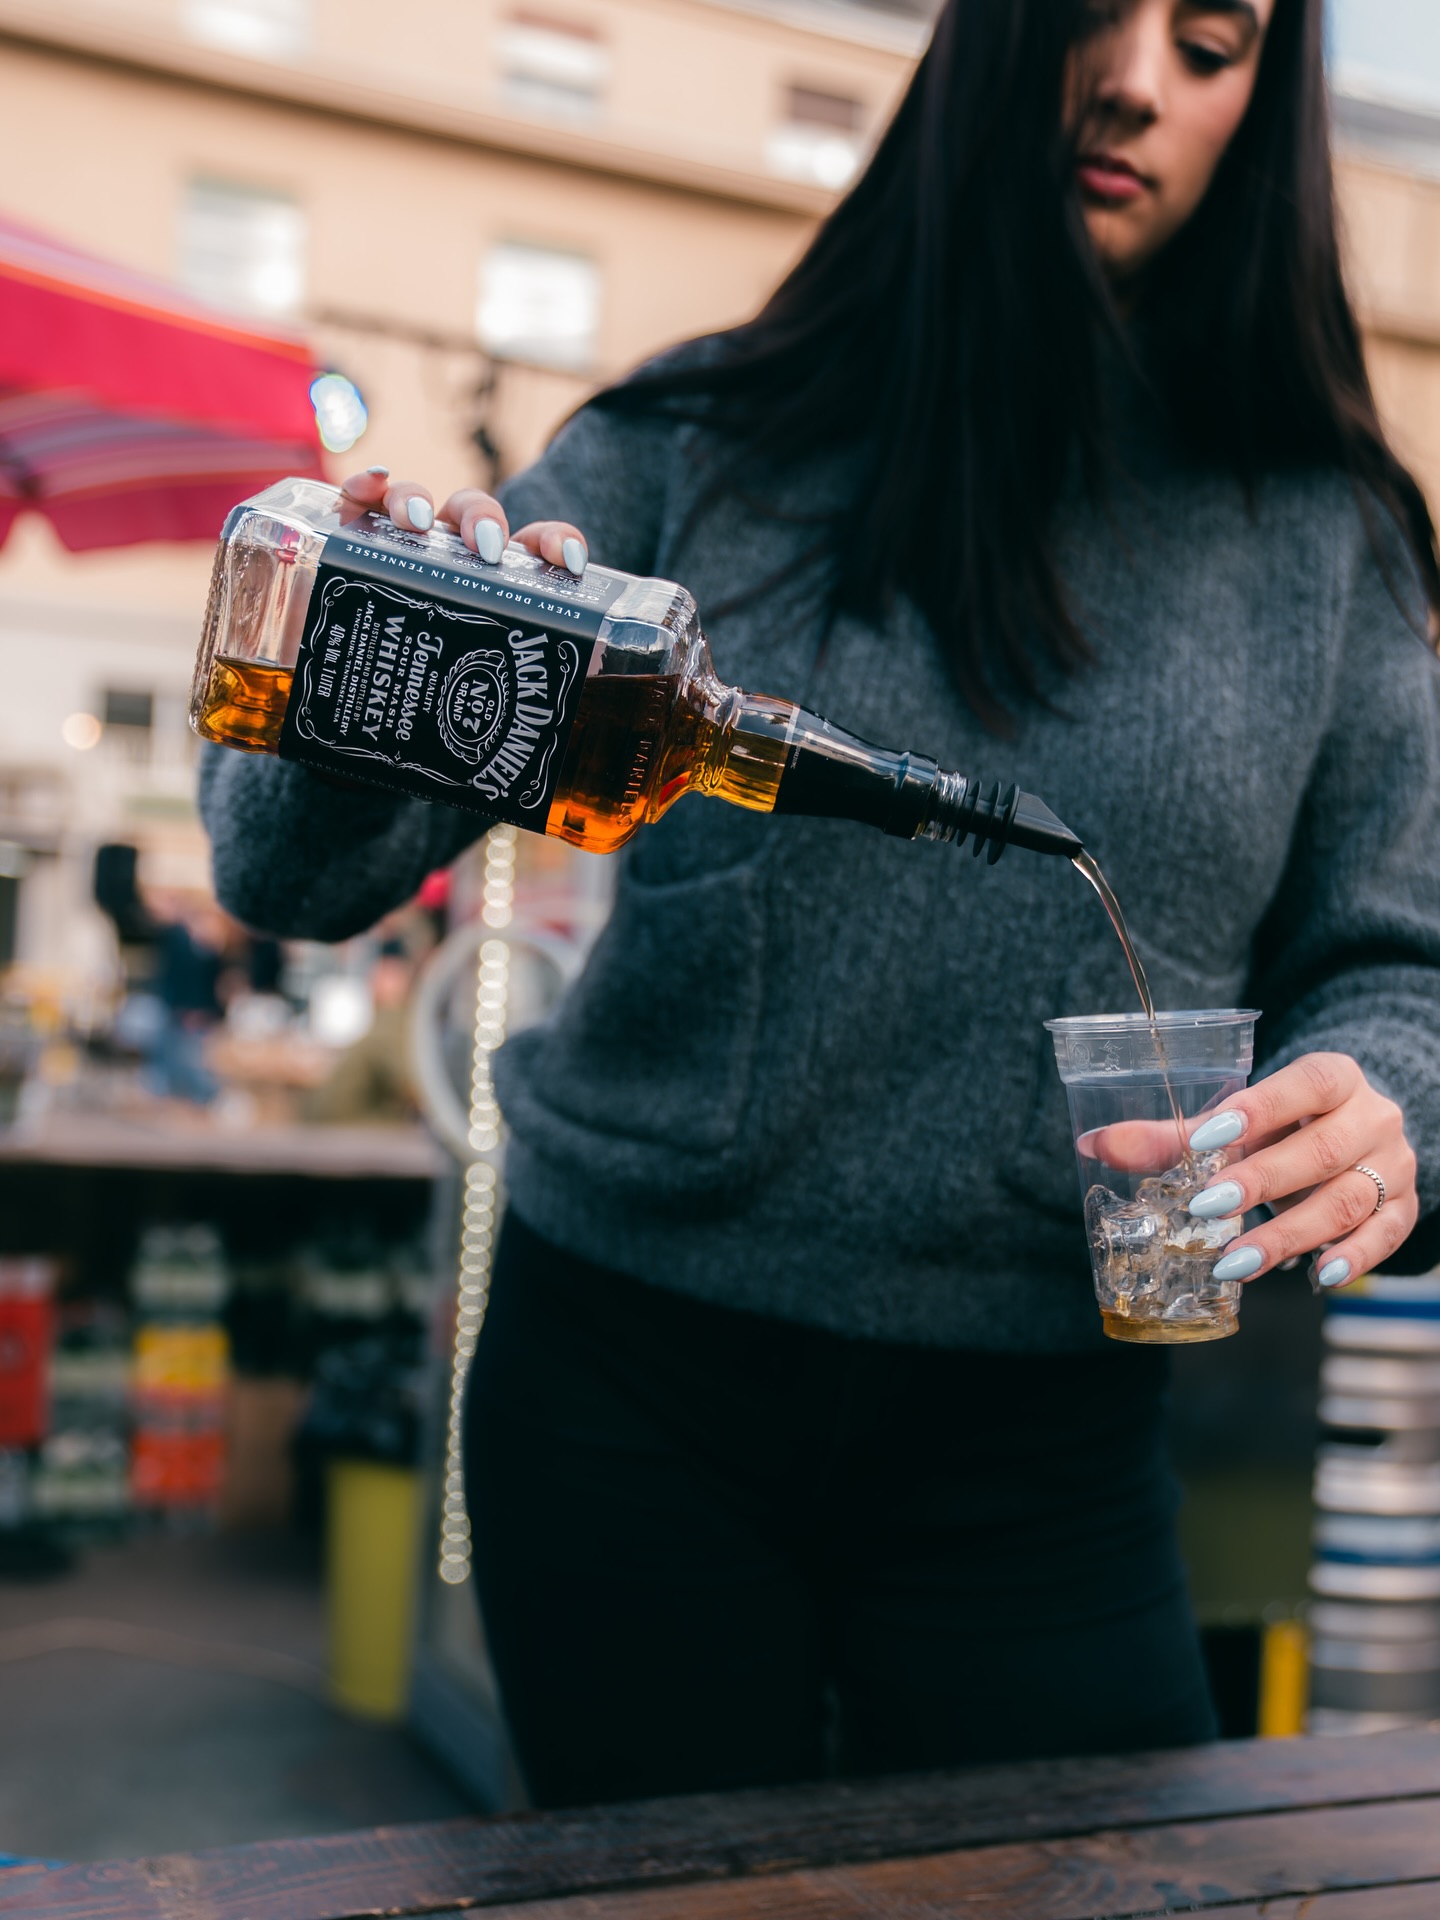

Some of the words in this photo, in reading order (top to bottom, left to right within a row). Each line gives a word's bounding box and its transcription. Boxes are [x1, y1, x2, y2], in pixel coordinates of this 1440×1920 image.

[345, 544, 424, 573] TENNESSEE
[430, 569, 446, 580] IN
[452, 576, 491, 593] MADE
[496, 589, 532, 605] DROP
[537, 601, 581, 619] EVERY
[362, 600, 375, 631] JACK
[327, 623, 346, 647] 40%
[366, 622, 381, 660] DISTILLED
[352, 632, 369, 672] DANIEL
[396, 635, 413, 677] SOUR
[507, 629, 549, 700] JACK
[322, 667, 337, 675] 1
[361, 616, 406, 742] WHISKEY
[362, 660, 372, 677] AND
[317, 673, 334, 698] LITER
[355, 678, 368, 711] BOTTLED
[395, 631, 444, 741] Tennessee
[422, 670, 439, 714] QUALITY
[333, 707, 341, 723] USA
[339, 674, 360, 736] DISTILLERY
[385, 683, 402, 729] MASH
[447, 681, 470, 722] BRAND
[484, 699, 496, 721] OLD
[352, 712, 361, 723] BY
[470, 701, 554, 802] DANIEL'S
